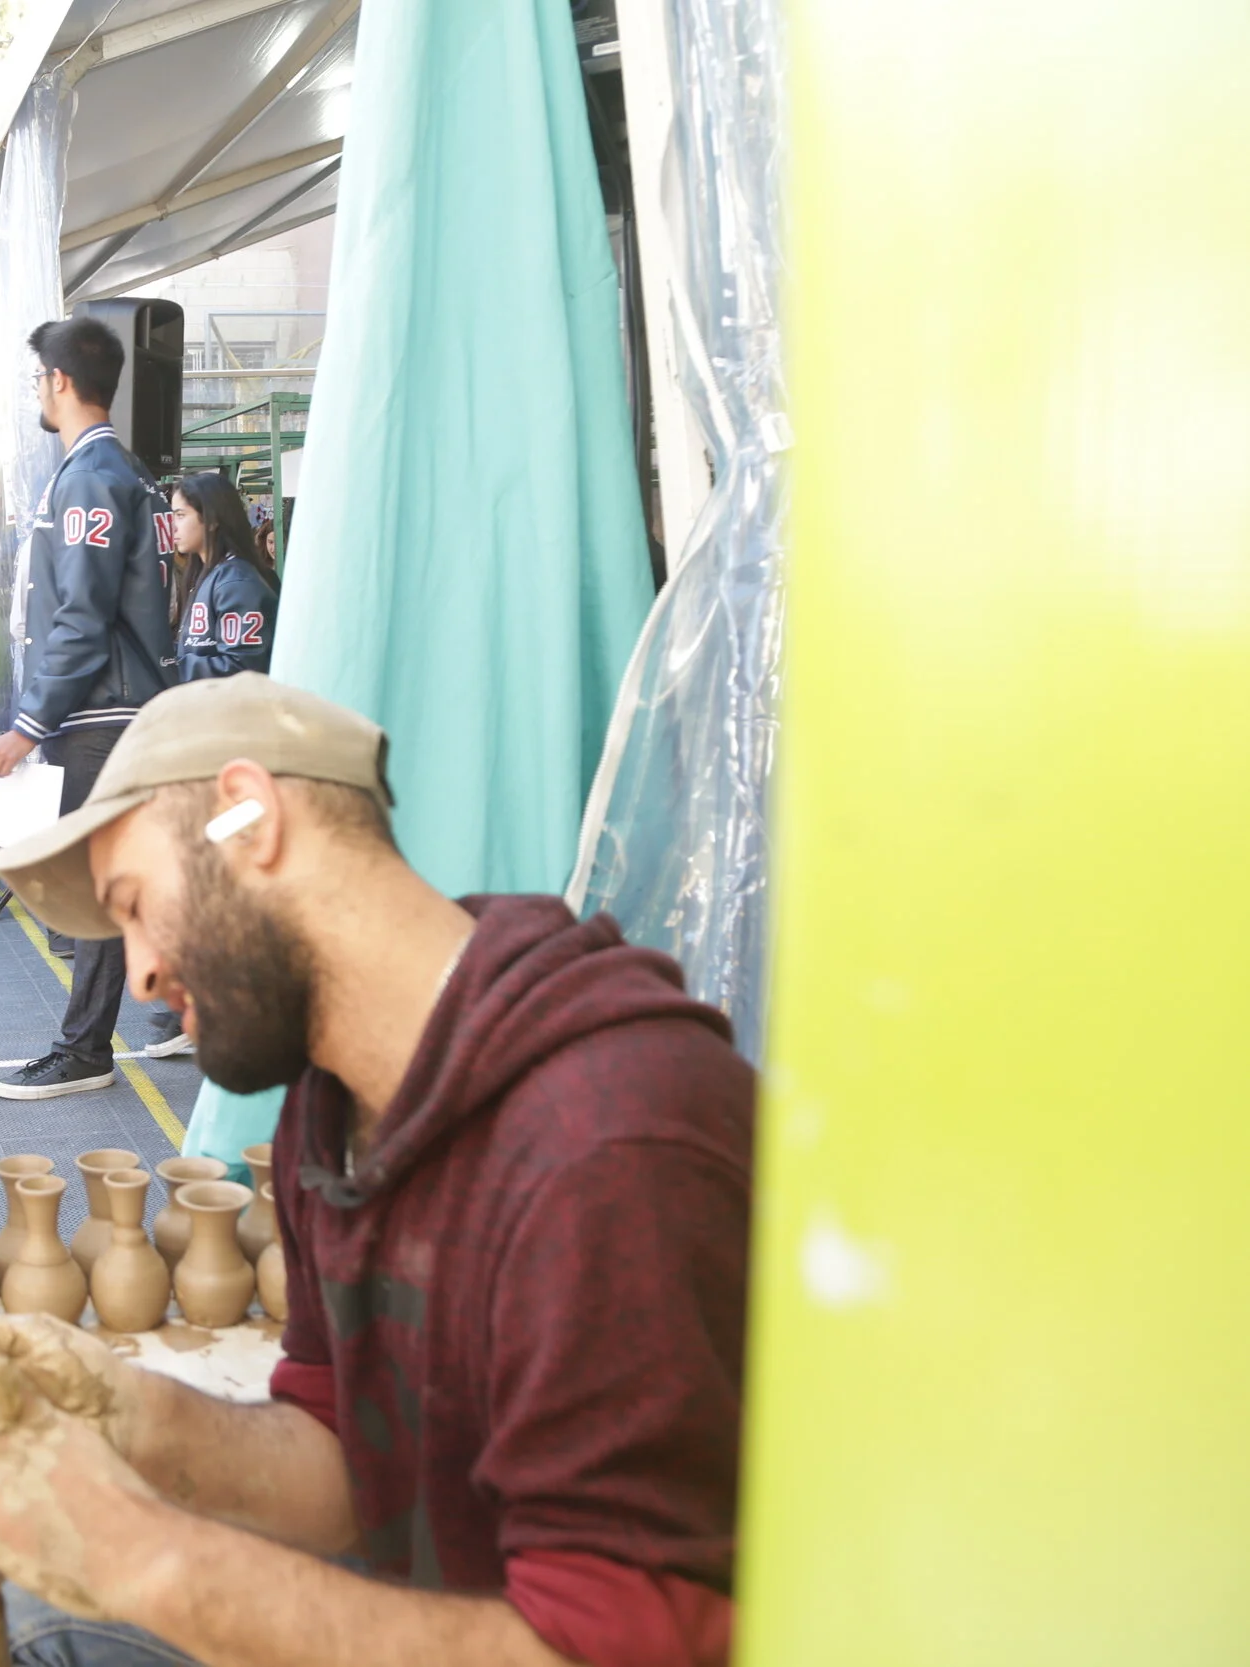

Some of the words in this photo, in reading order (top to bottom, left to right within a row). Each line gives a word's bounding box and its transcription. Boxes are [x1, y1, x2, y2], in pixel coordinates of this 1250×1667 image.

[63, 506, 113, 548] 02
[189, 602, 209, 635] B
[221, 611, 264, 646] 02
